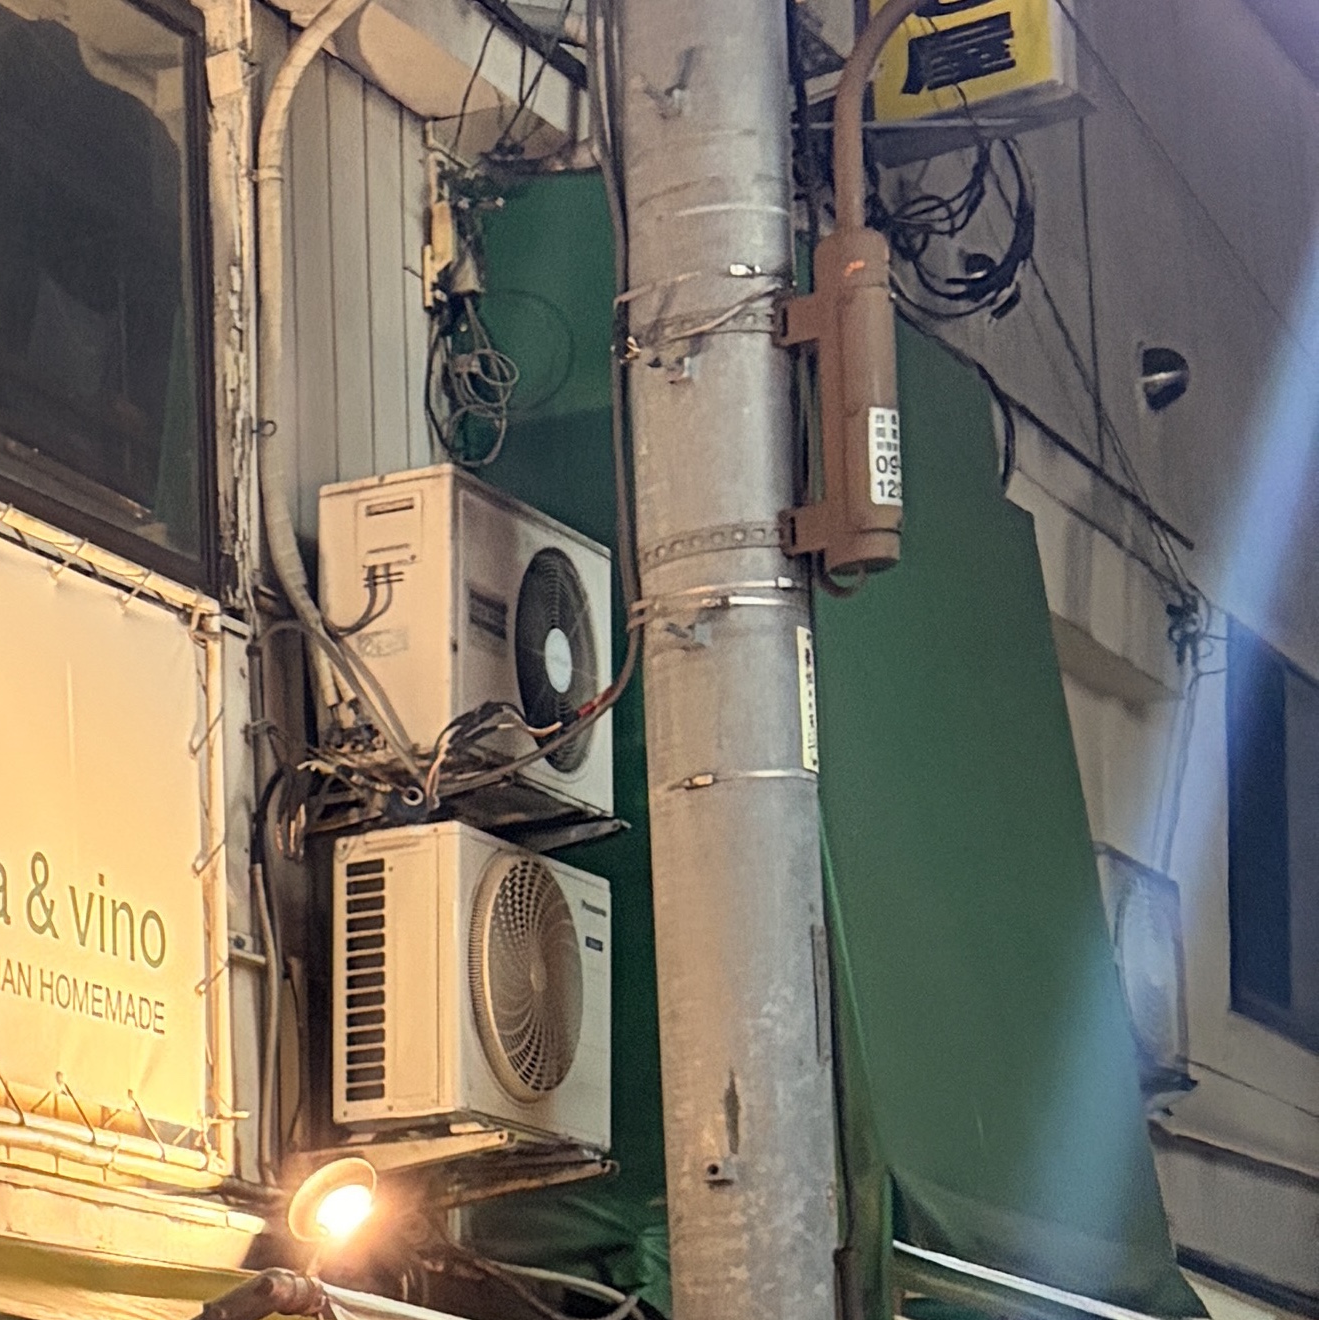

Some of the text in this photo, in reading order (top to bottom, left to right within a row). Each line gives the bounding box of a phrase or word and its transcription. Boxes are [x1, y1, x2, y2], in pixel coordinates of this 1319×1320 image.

[25, 850, 61, 940] &
[67, 872, 168, 970] vino
[39, 970, 167, 1036] HOMEMADE
